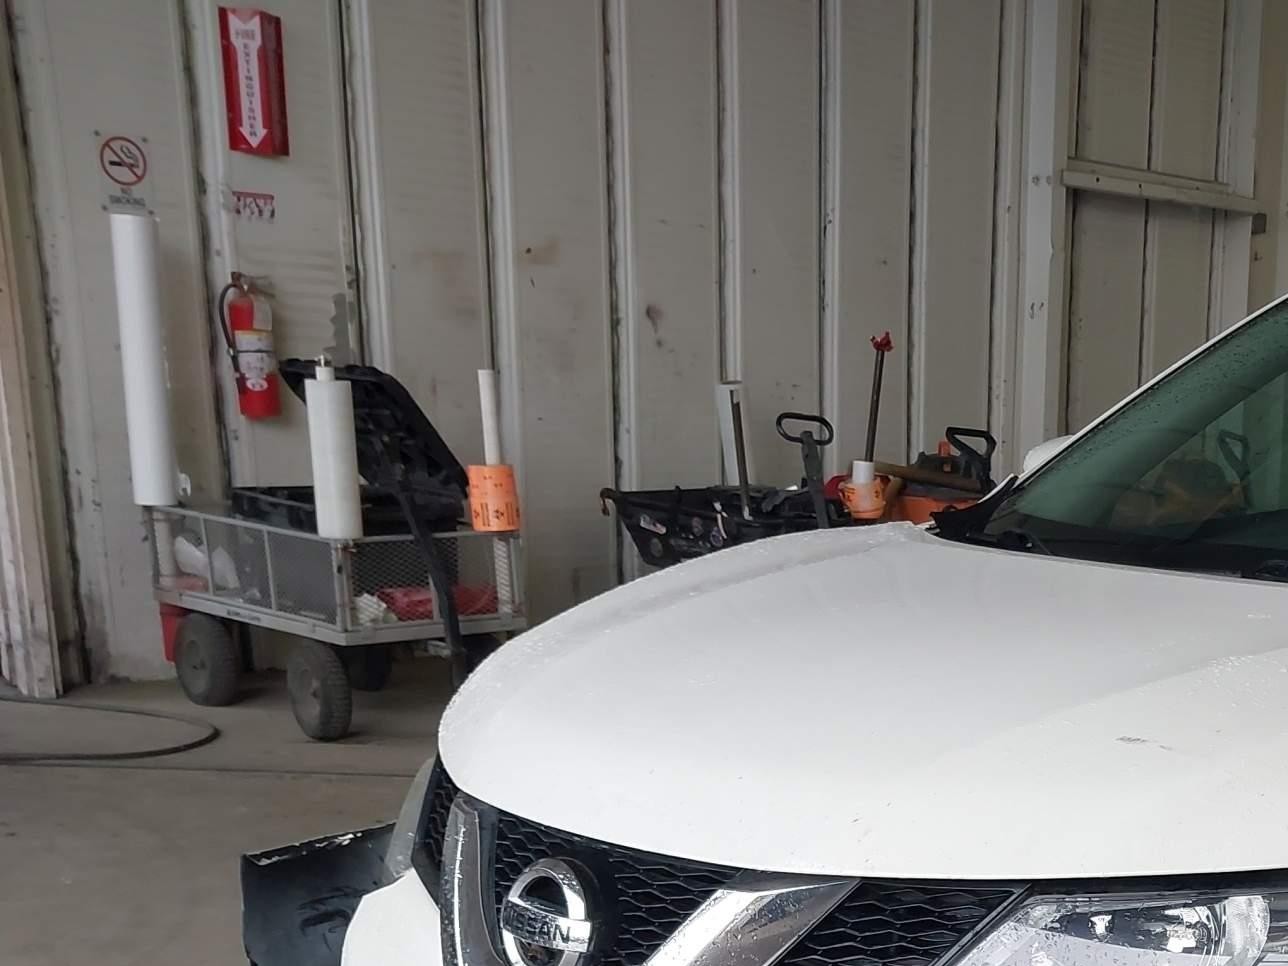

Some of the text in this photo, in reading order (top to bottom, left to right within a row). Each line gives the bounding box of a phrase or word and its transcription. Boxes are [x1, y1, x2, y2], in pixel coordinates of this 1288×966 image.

[234, 29, 256, 41] FIRE
[242, 43, 258, 138] EXTINGUISHER
[108, 194, 146, 208] SMOKING
[503, 904, 571, 944] NISSAN
